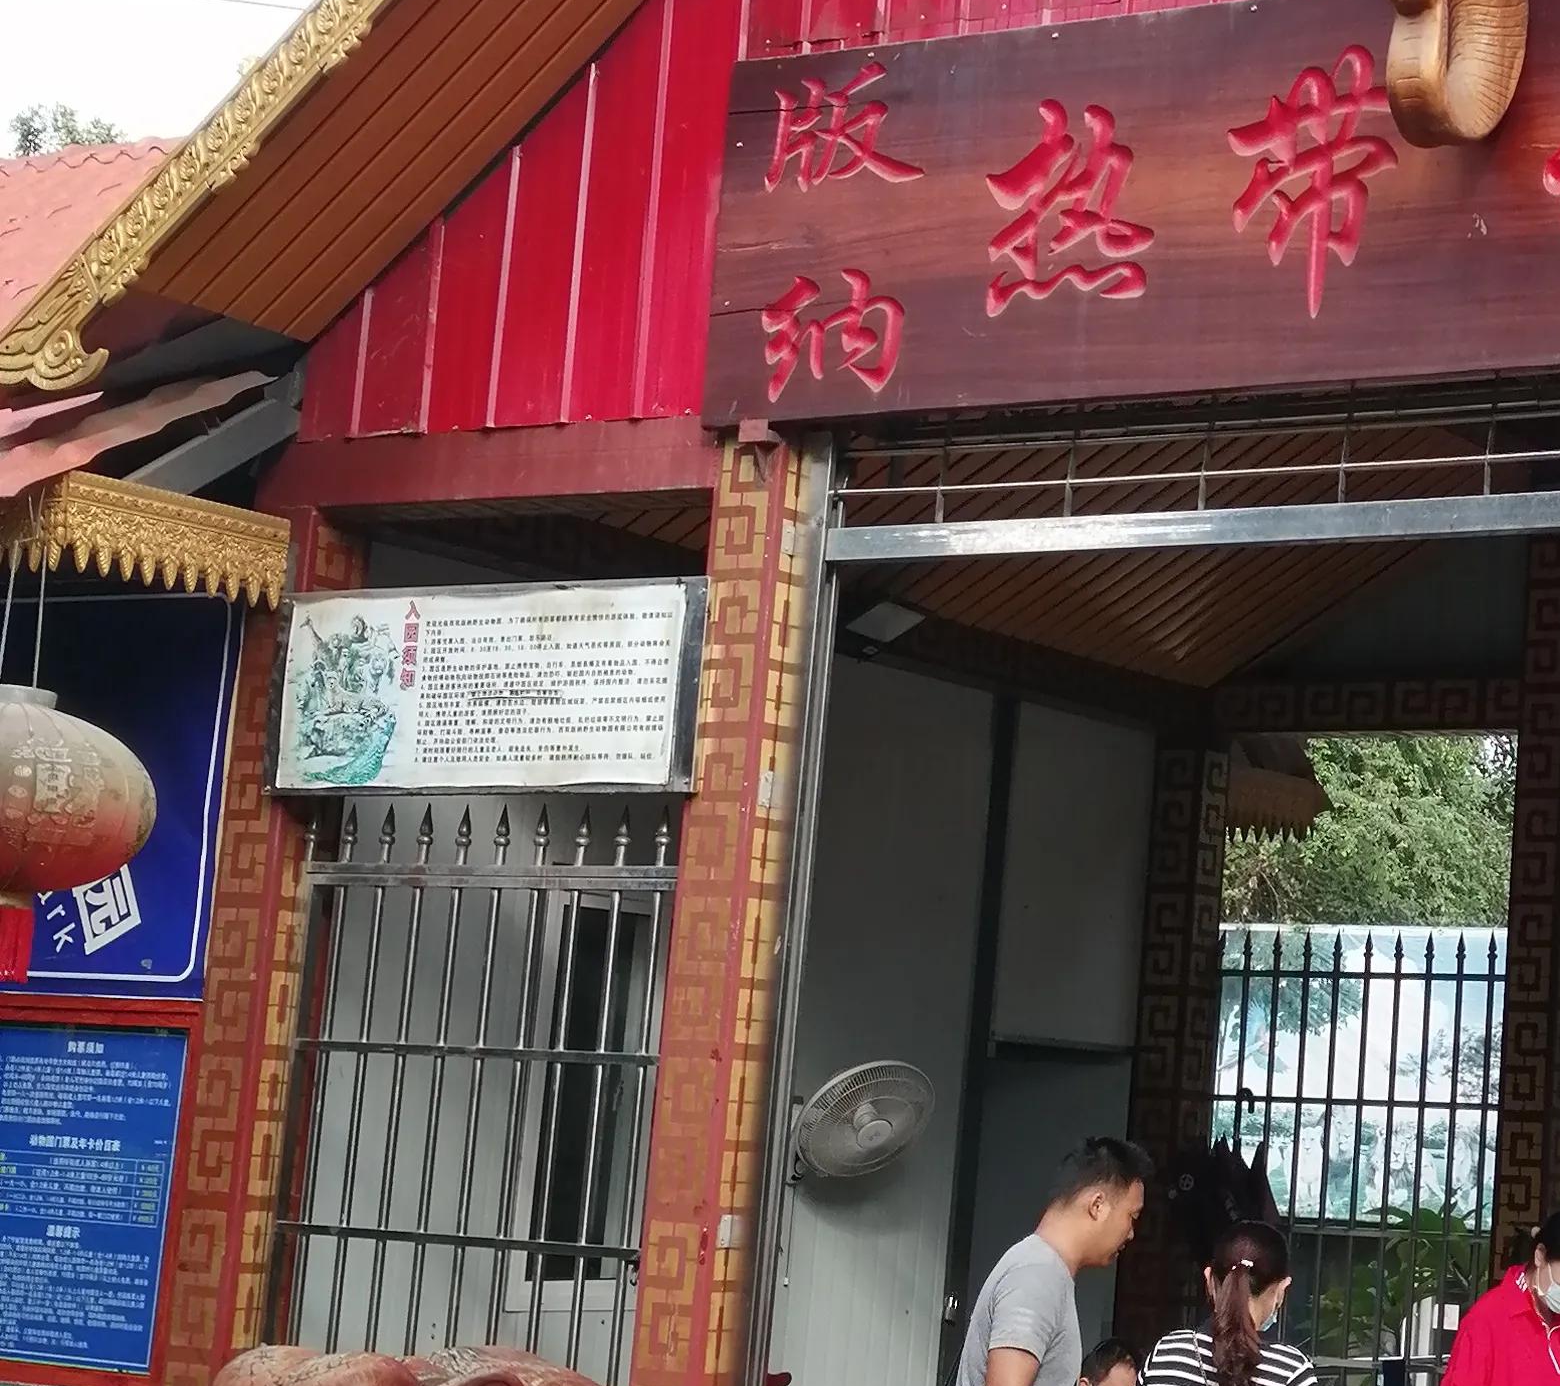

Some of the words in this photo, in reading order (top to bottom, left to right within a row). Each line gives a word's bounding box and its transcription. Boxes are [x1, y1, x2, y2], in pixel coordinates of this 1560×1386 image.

[760, 61, 925, 405] 版纳
[400, 600, 421, 691] 入园须知
